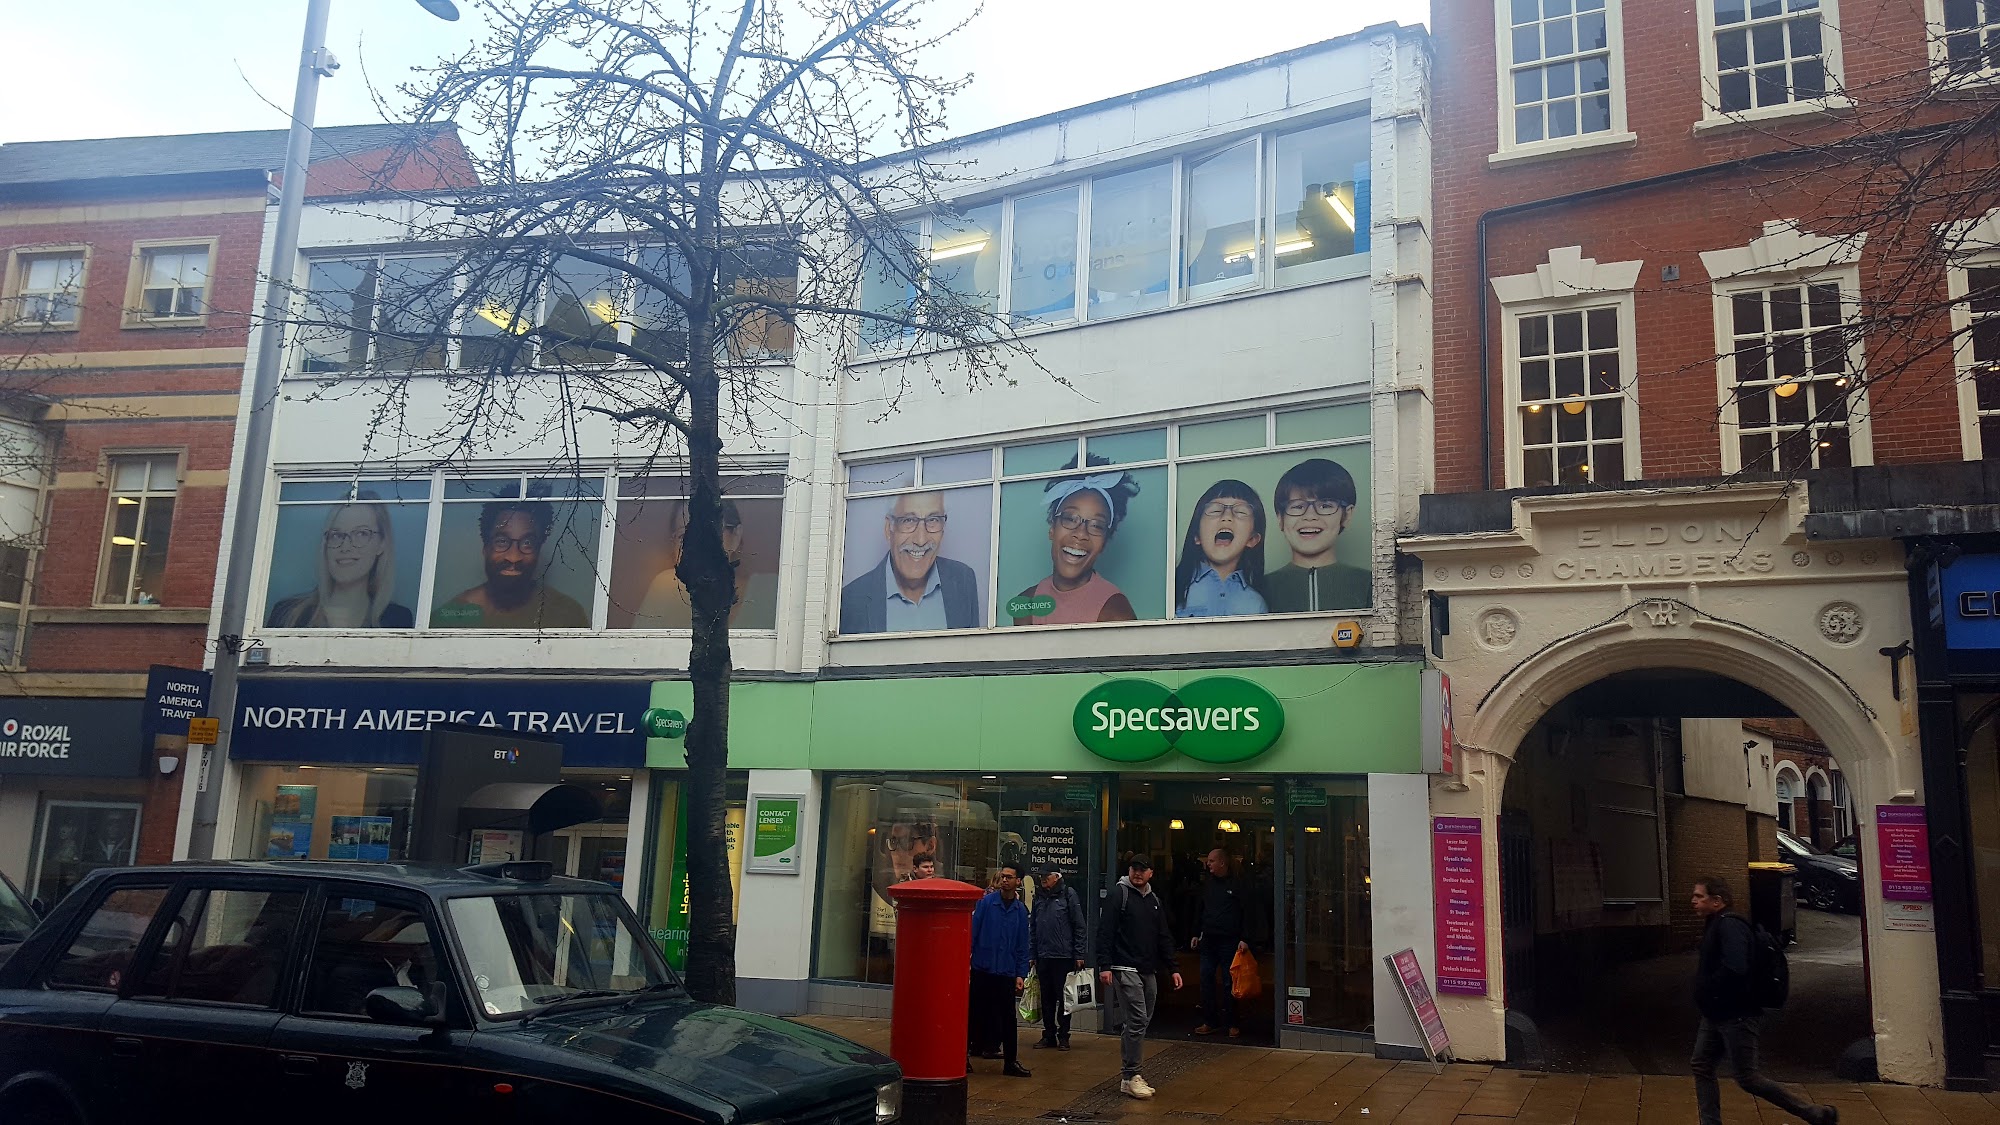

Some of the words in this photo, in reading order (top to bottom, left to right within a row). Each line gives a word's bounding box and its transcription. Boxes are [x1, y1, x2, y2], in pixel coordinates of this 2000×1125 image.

[1578, 519, 1742, 548] ELDON
[1552, 551, 1775, 579] CHAMBERS
[1010, 602, 1051, 612] Specsavers
[1960, 591, 2000, 617] C
[167, 682, 199, 694] NORTH
[159, 695, 203, 708] AMERICA
[243, 707, 346, 729] NORTH
[507, 711, 635, 733] TRAVEL
[655, 716, 683, 729] Specsavers
[1092, 701, 1260, 739] Specsavers
[21, 725, 71, 741] ROYAL
[20, 742, 70, 758] FORCE
[494, 750, 507, 760] BT
[1192, 793, 1239, 805] Welcome
[1242, 795, 1252, 805] to
[1261, 796, 1274, 805] Spe
[1033, 824, 1049, 833] Our
[1051, 826, 1074, 834] most
[1032, 835, 1074, 844] advanced
[1032, 846, 1046, 854] eye
[1049, 847, 1072, 855] exam
[1031, 854, 1046, 863] has
[1048, 855, 1078, 864] landed
